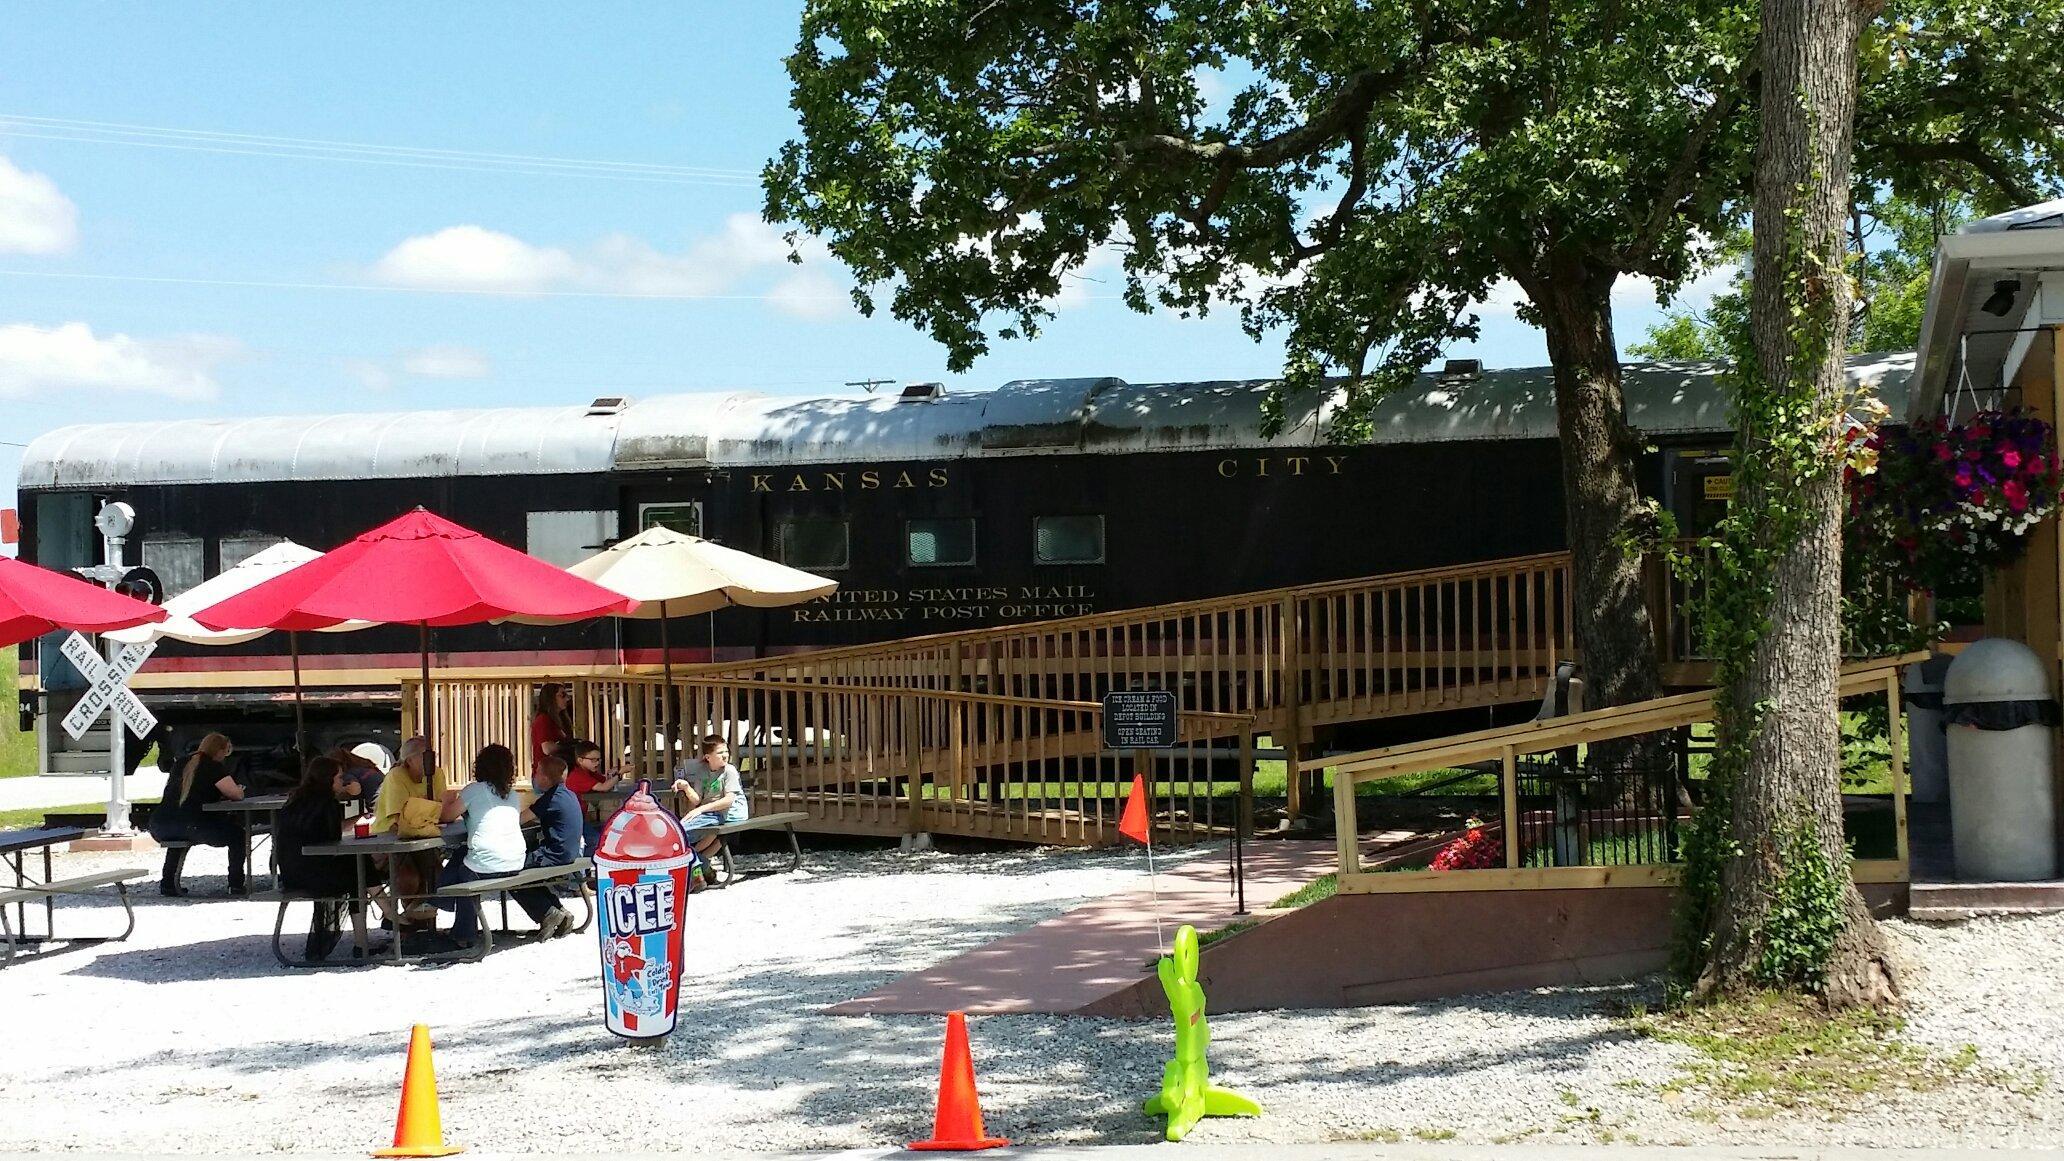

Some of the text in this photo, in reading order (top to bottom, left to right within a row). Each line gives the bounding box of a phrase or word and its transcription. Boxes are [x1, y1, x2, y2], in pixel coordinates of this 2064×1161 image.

[750, 456, 1348, 493] KANSAS CITY
[814, 585, 1095, 604] NITED STATES MAIL
[793, 603, 1093, 622] RAILWAY POST OFFICE
[66, 638, 151, 735] RAIL ROAD
[1112, 695, 1122, 703] ICE
[1123, 695, 1145, 703] CREAM
[1151, 695, 1167, 703] FOOD
[1121, 703, 1158, 712] LOCATED IN
[1113, 712, 1166, 721] DEPOT BUILDING
[1117, 727, 1162, 736] OPEN SEATING
[1120, 736, 1159, 744] IN RAIL CAR
[605, 880, 675, 937] ICEE
